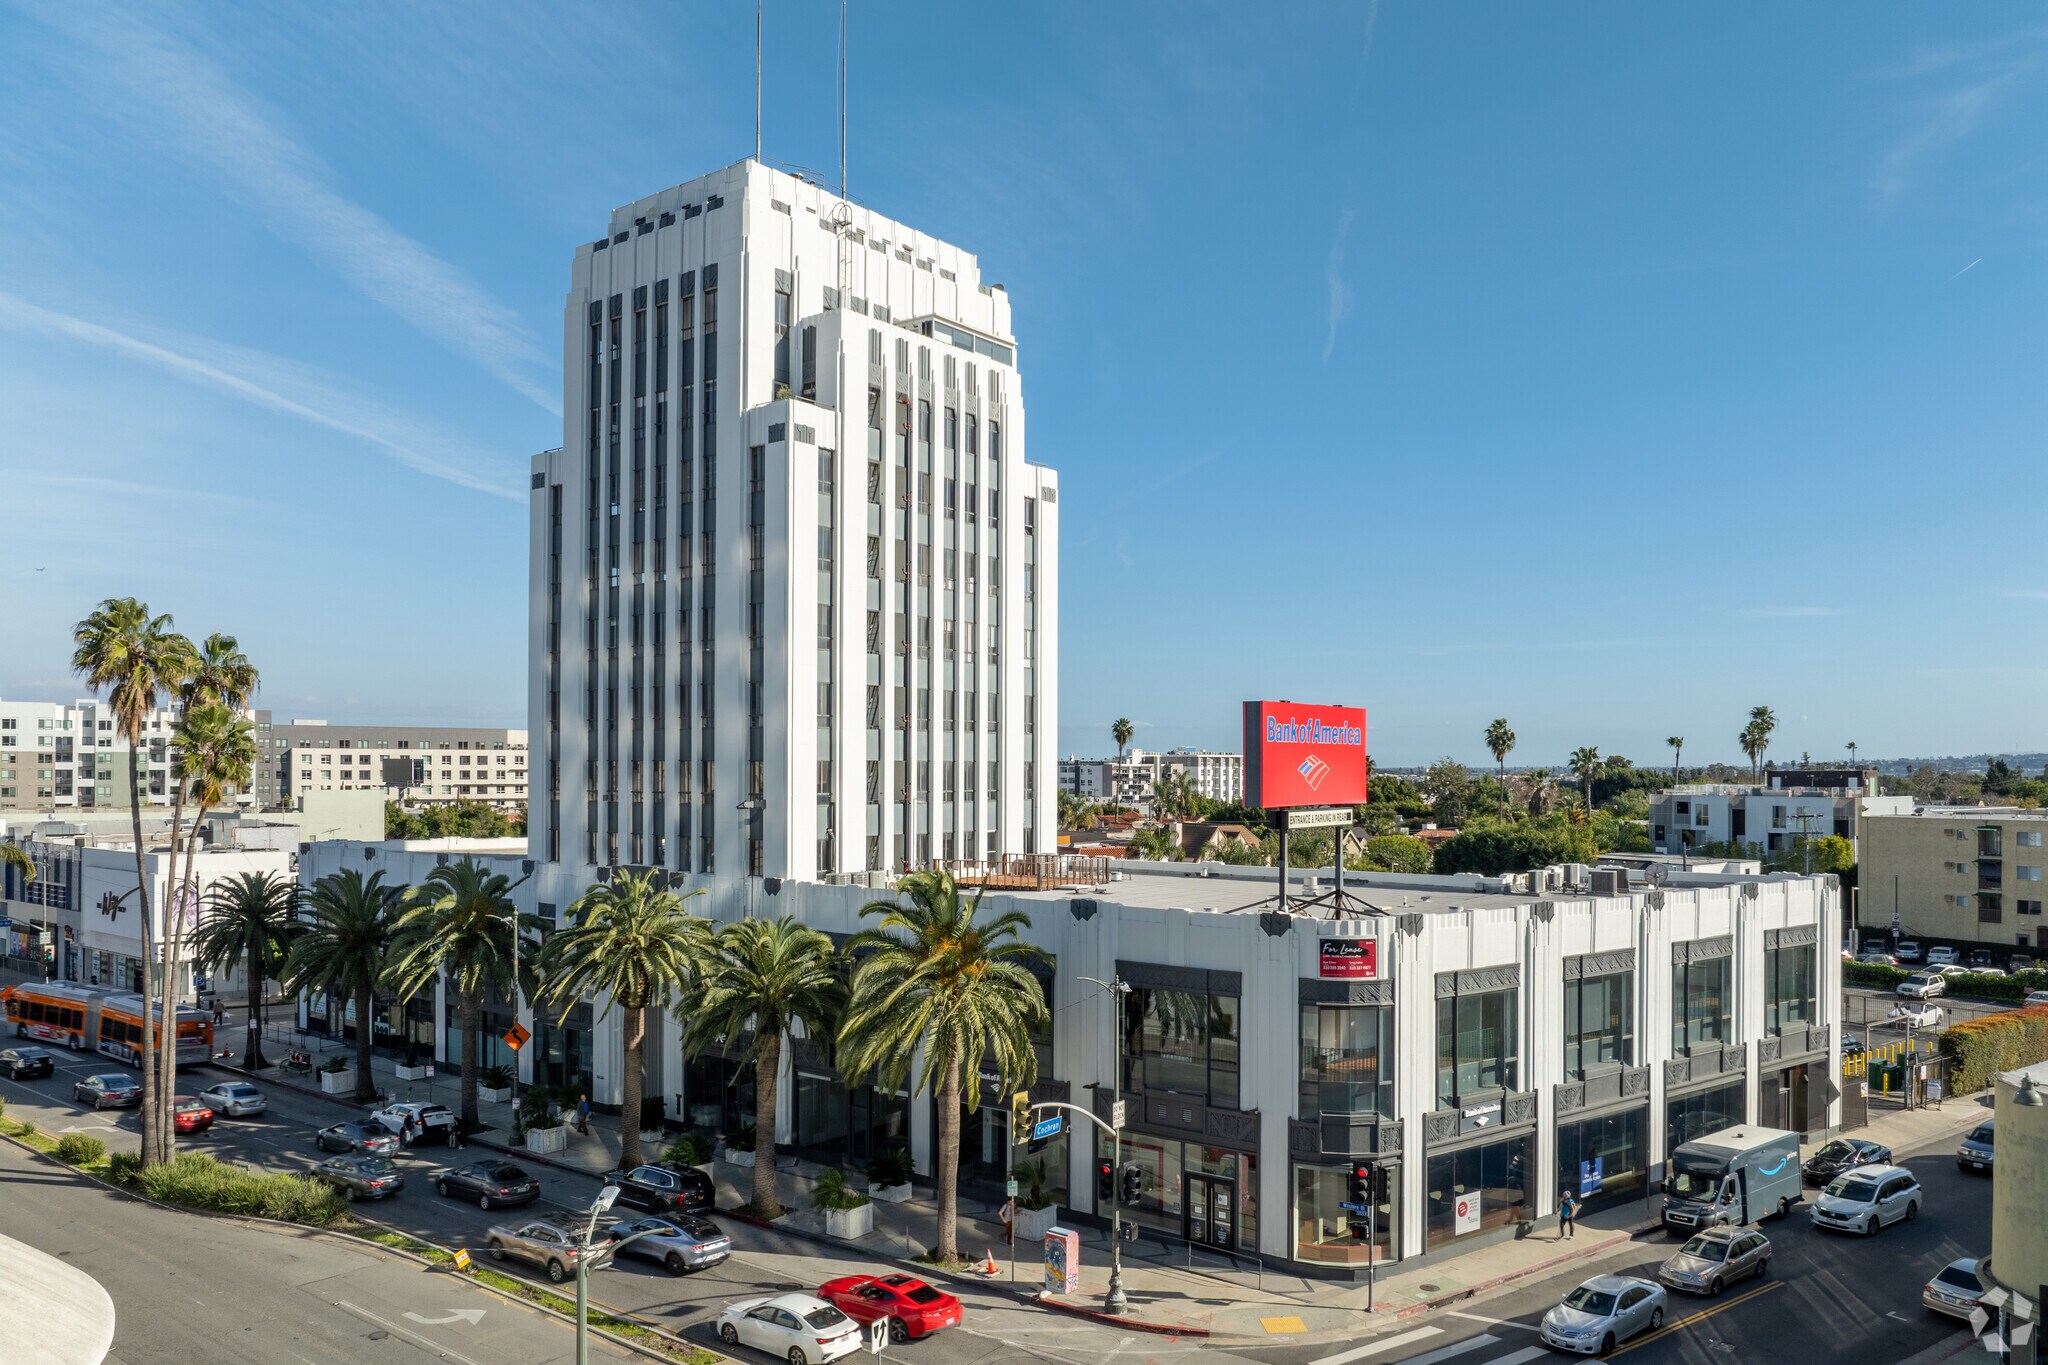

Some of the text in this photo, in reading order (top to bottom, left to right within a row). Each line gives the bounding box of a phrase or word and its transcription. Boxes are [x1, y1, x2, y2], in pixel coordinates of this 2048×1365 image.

[1266, 716, 1362, 745] Bank of America
[1290, 815, 1311, 825] ENTRANCE
[1315, 813, 1332, 823] PARKING
[1337, 812, 1348, 822] REAR
[1322, 943, 1363, 955] For Lease
[978, 1071, 991, 1080] Bank
[1113, 1112, 1125, 1120] BLOCK
[1464, 1108, 1478, 1118] Bank
[1482, 1103, 1502, 1114] America
[1036, 1121, 1060, 1136] Cochran
